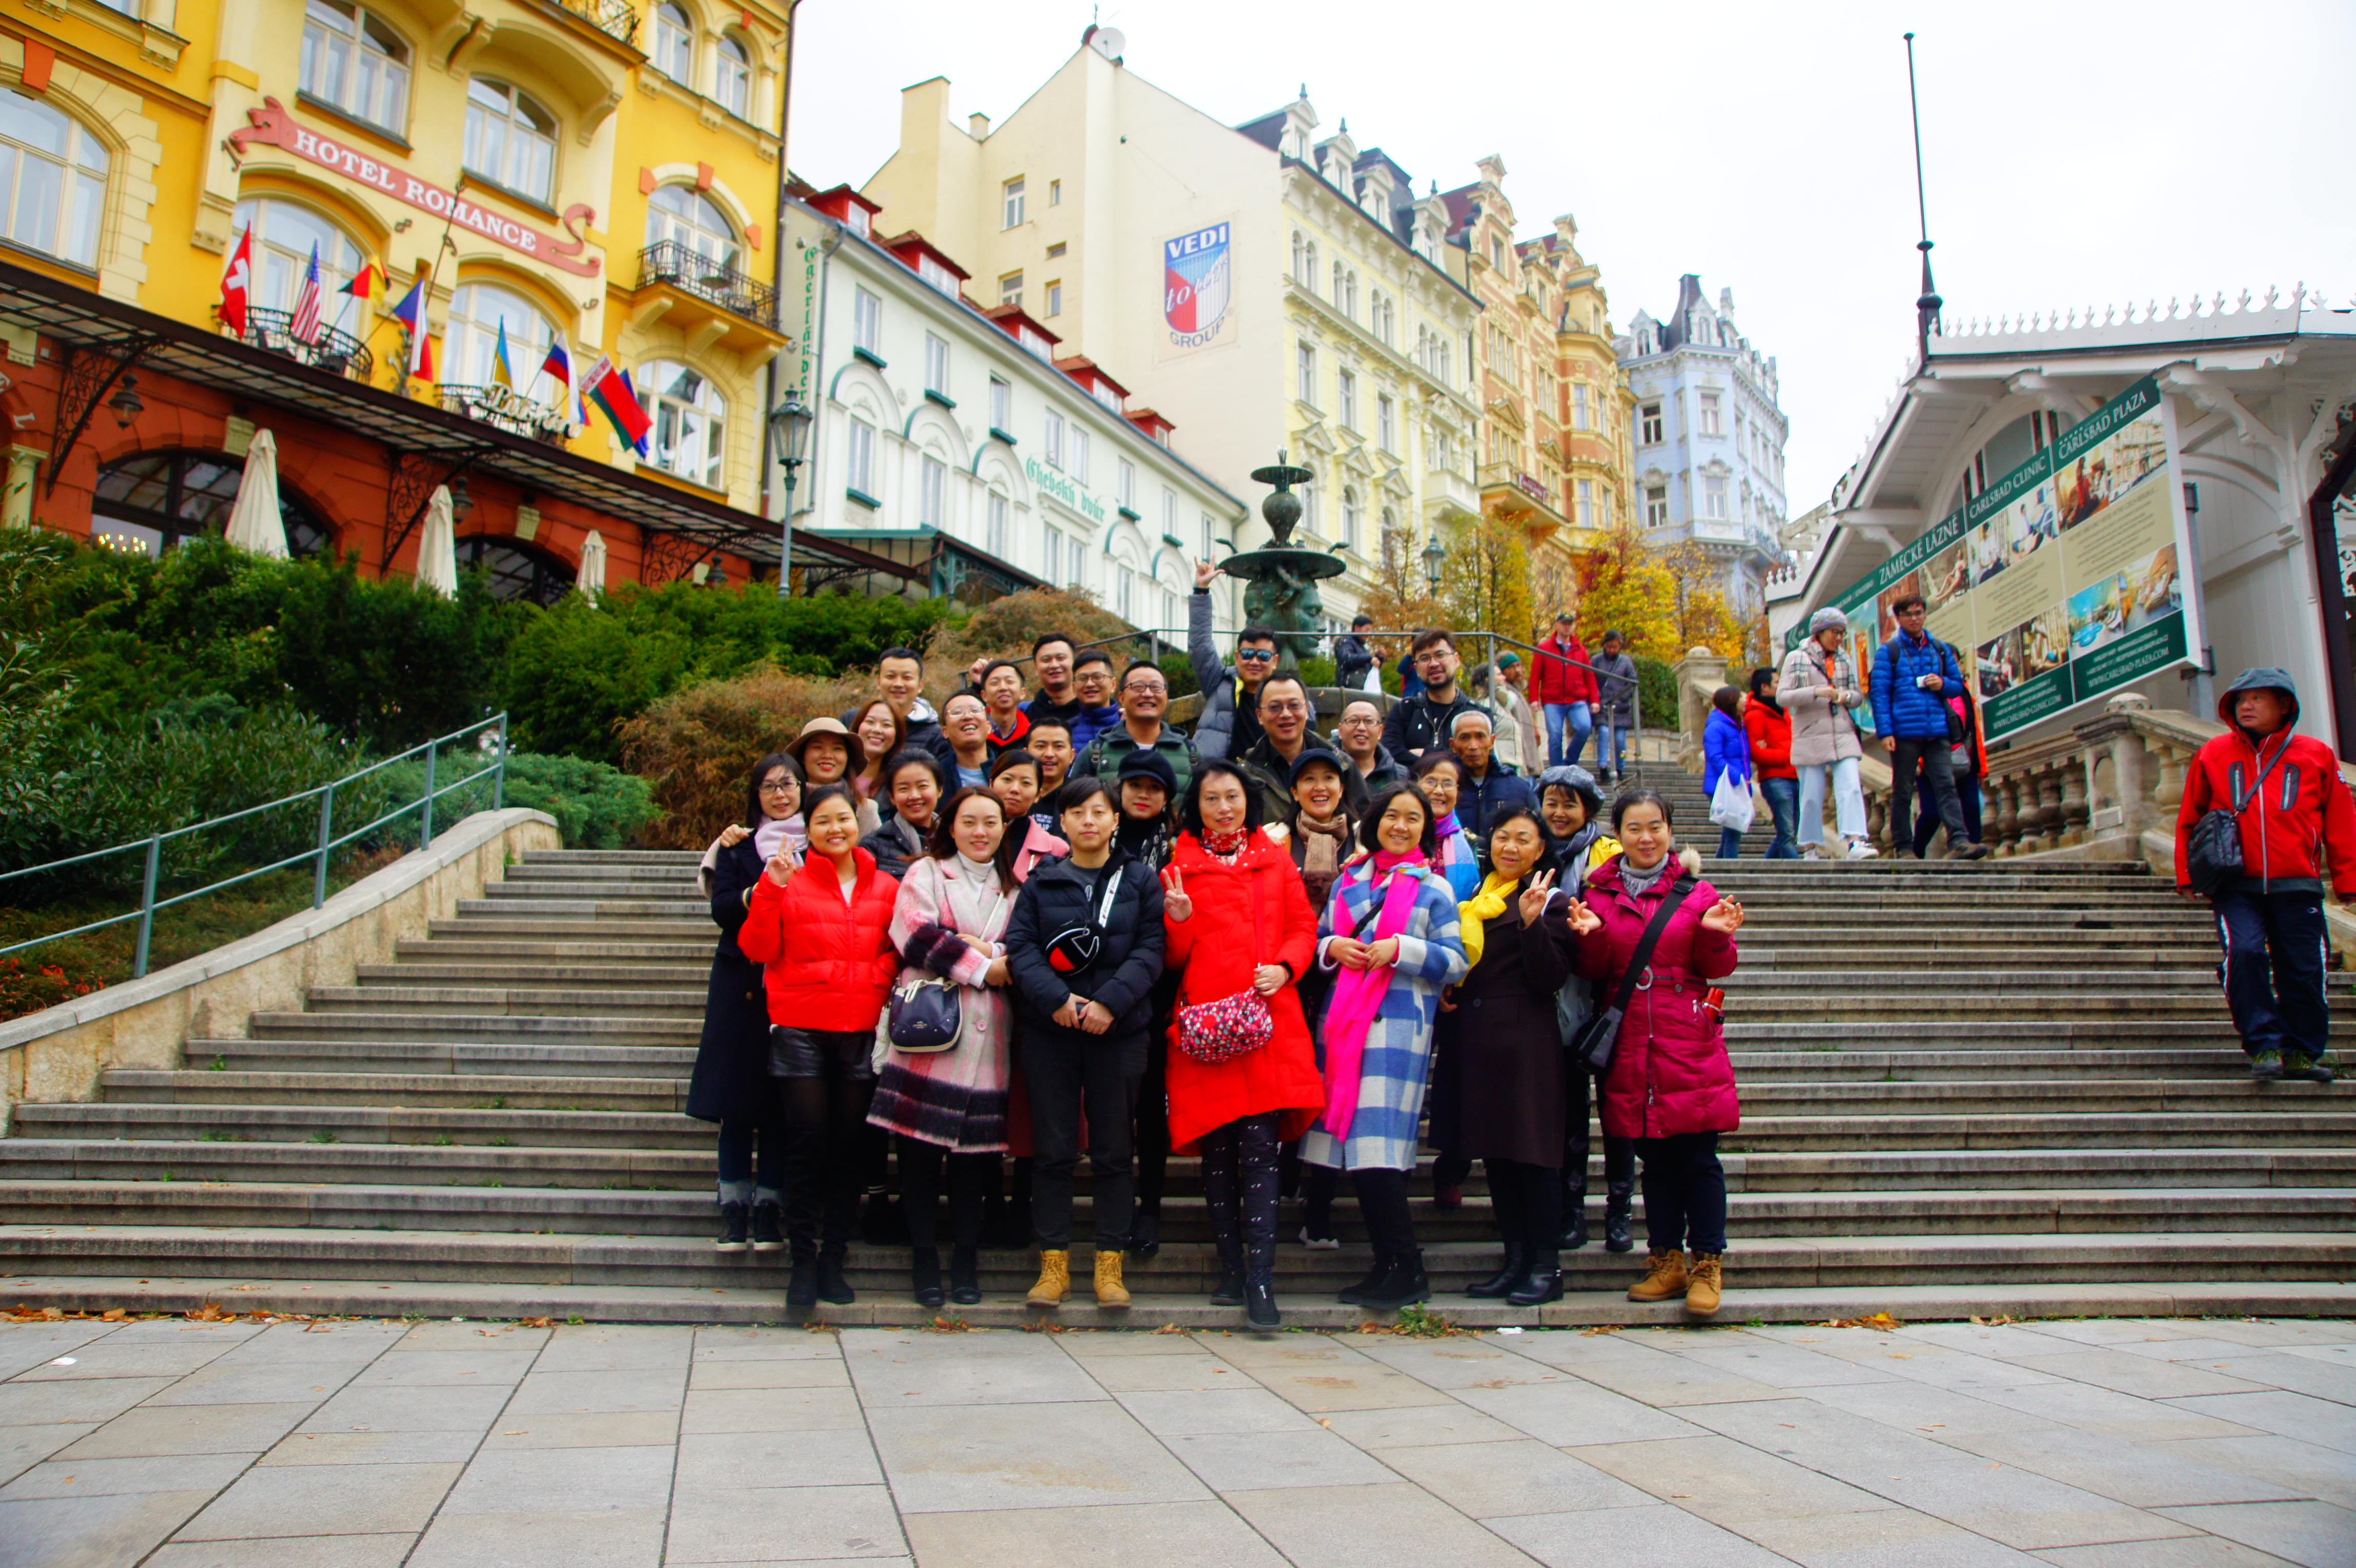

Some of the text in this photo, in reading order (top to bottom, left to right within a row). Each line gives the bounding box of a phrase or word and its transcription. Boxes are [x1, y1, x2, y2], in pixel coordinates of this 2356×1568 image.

[294, 129, 537, 251] HOTEL ROMANCE
[1168, 225, 1226, 258] VEDI
[1170, 316, 1225, 348] GROUP
[2059, 415, 2111, 459] CARLSBAD
[2113, 390, 2147, 423] PLAZA
[1969, 455, 2047, 519] CARLSBAD CLINIC
